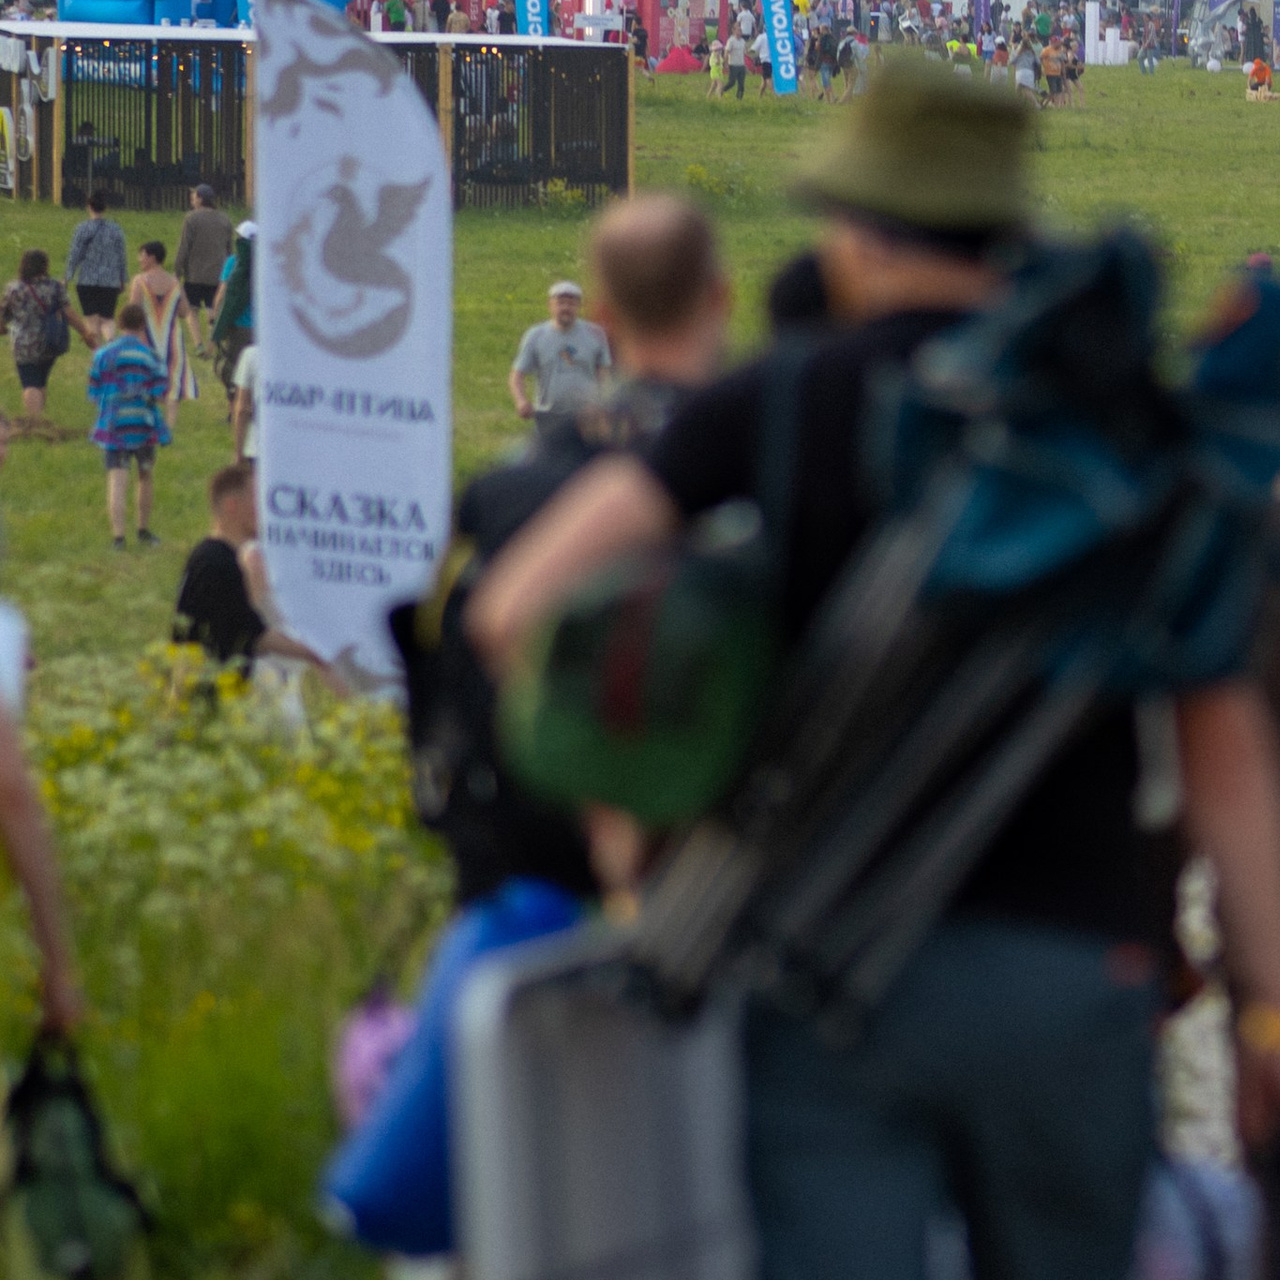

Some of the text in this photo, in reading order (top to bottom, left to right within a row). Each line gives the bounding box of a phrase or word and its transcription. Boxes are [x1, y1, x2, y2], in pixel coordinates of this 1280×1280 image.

[266, 483, 428, 533] СКАЗКА
[266, 523, 435, 562] НАЧИНАЕТСЯ
[311, 557, 392, 588] ЗДЕСЬ
